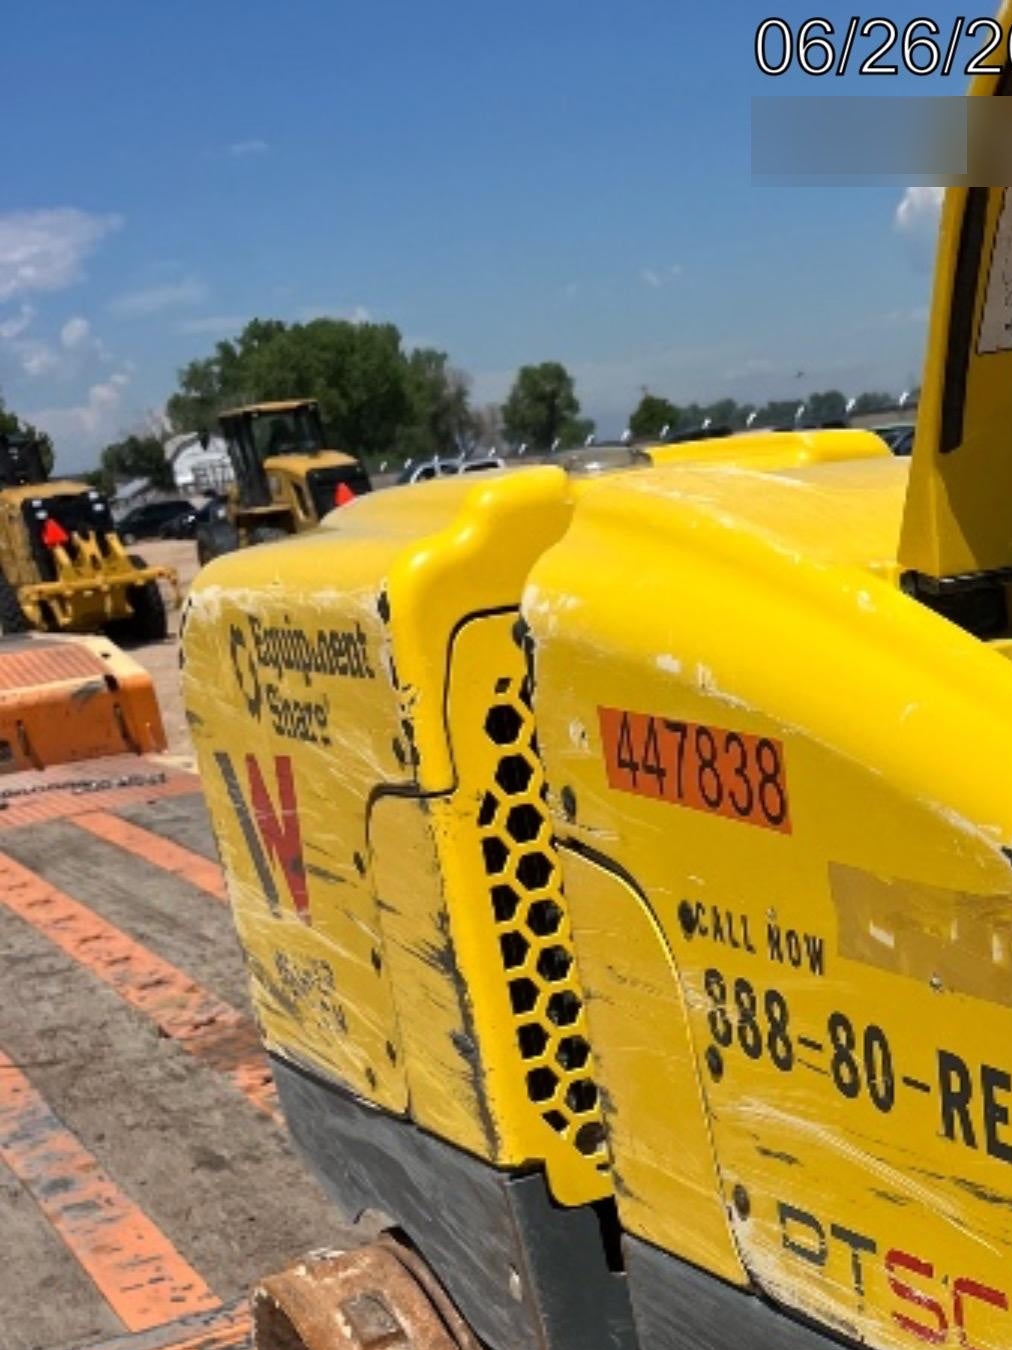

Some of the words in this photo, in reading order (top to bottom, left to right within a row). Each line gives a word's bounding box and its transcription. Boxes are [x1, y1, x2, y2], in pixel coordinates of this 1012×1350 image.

[615, 709, 787, 826] 447838
[695, 901, 756, 954] CALL
[767, 923, 826, 976] NOW
